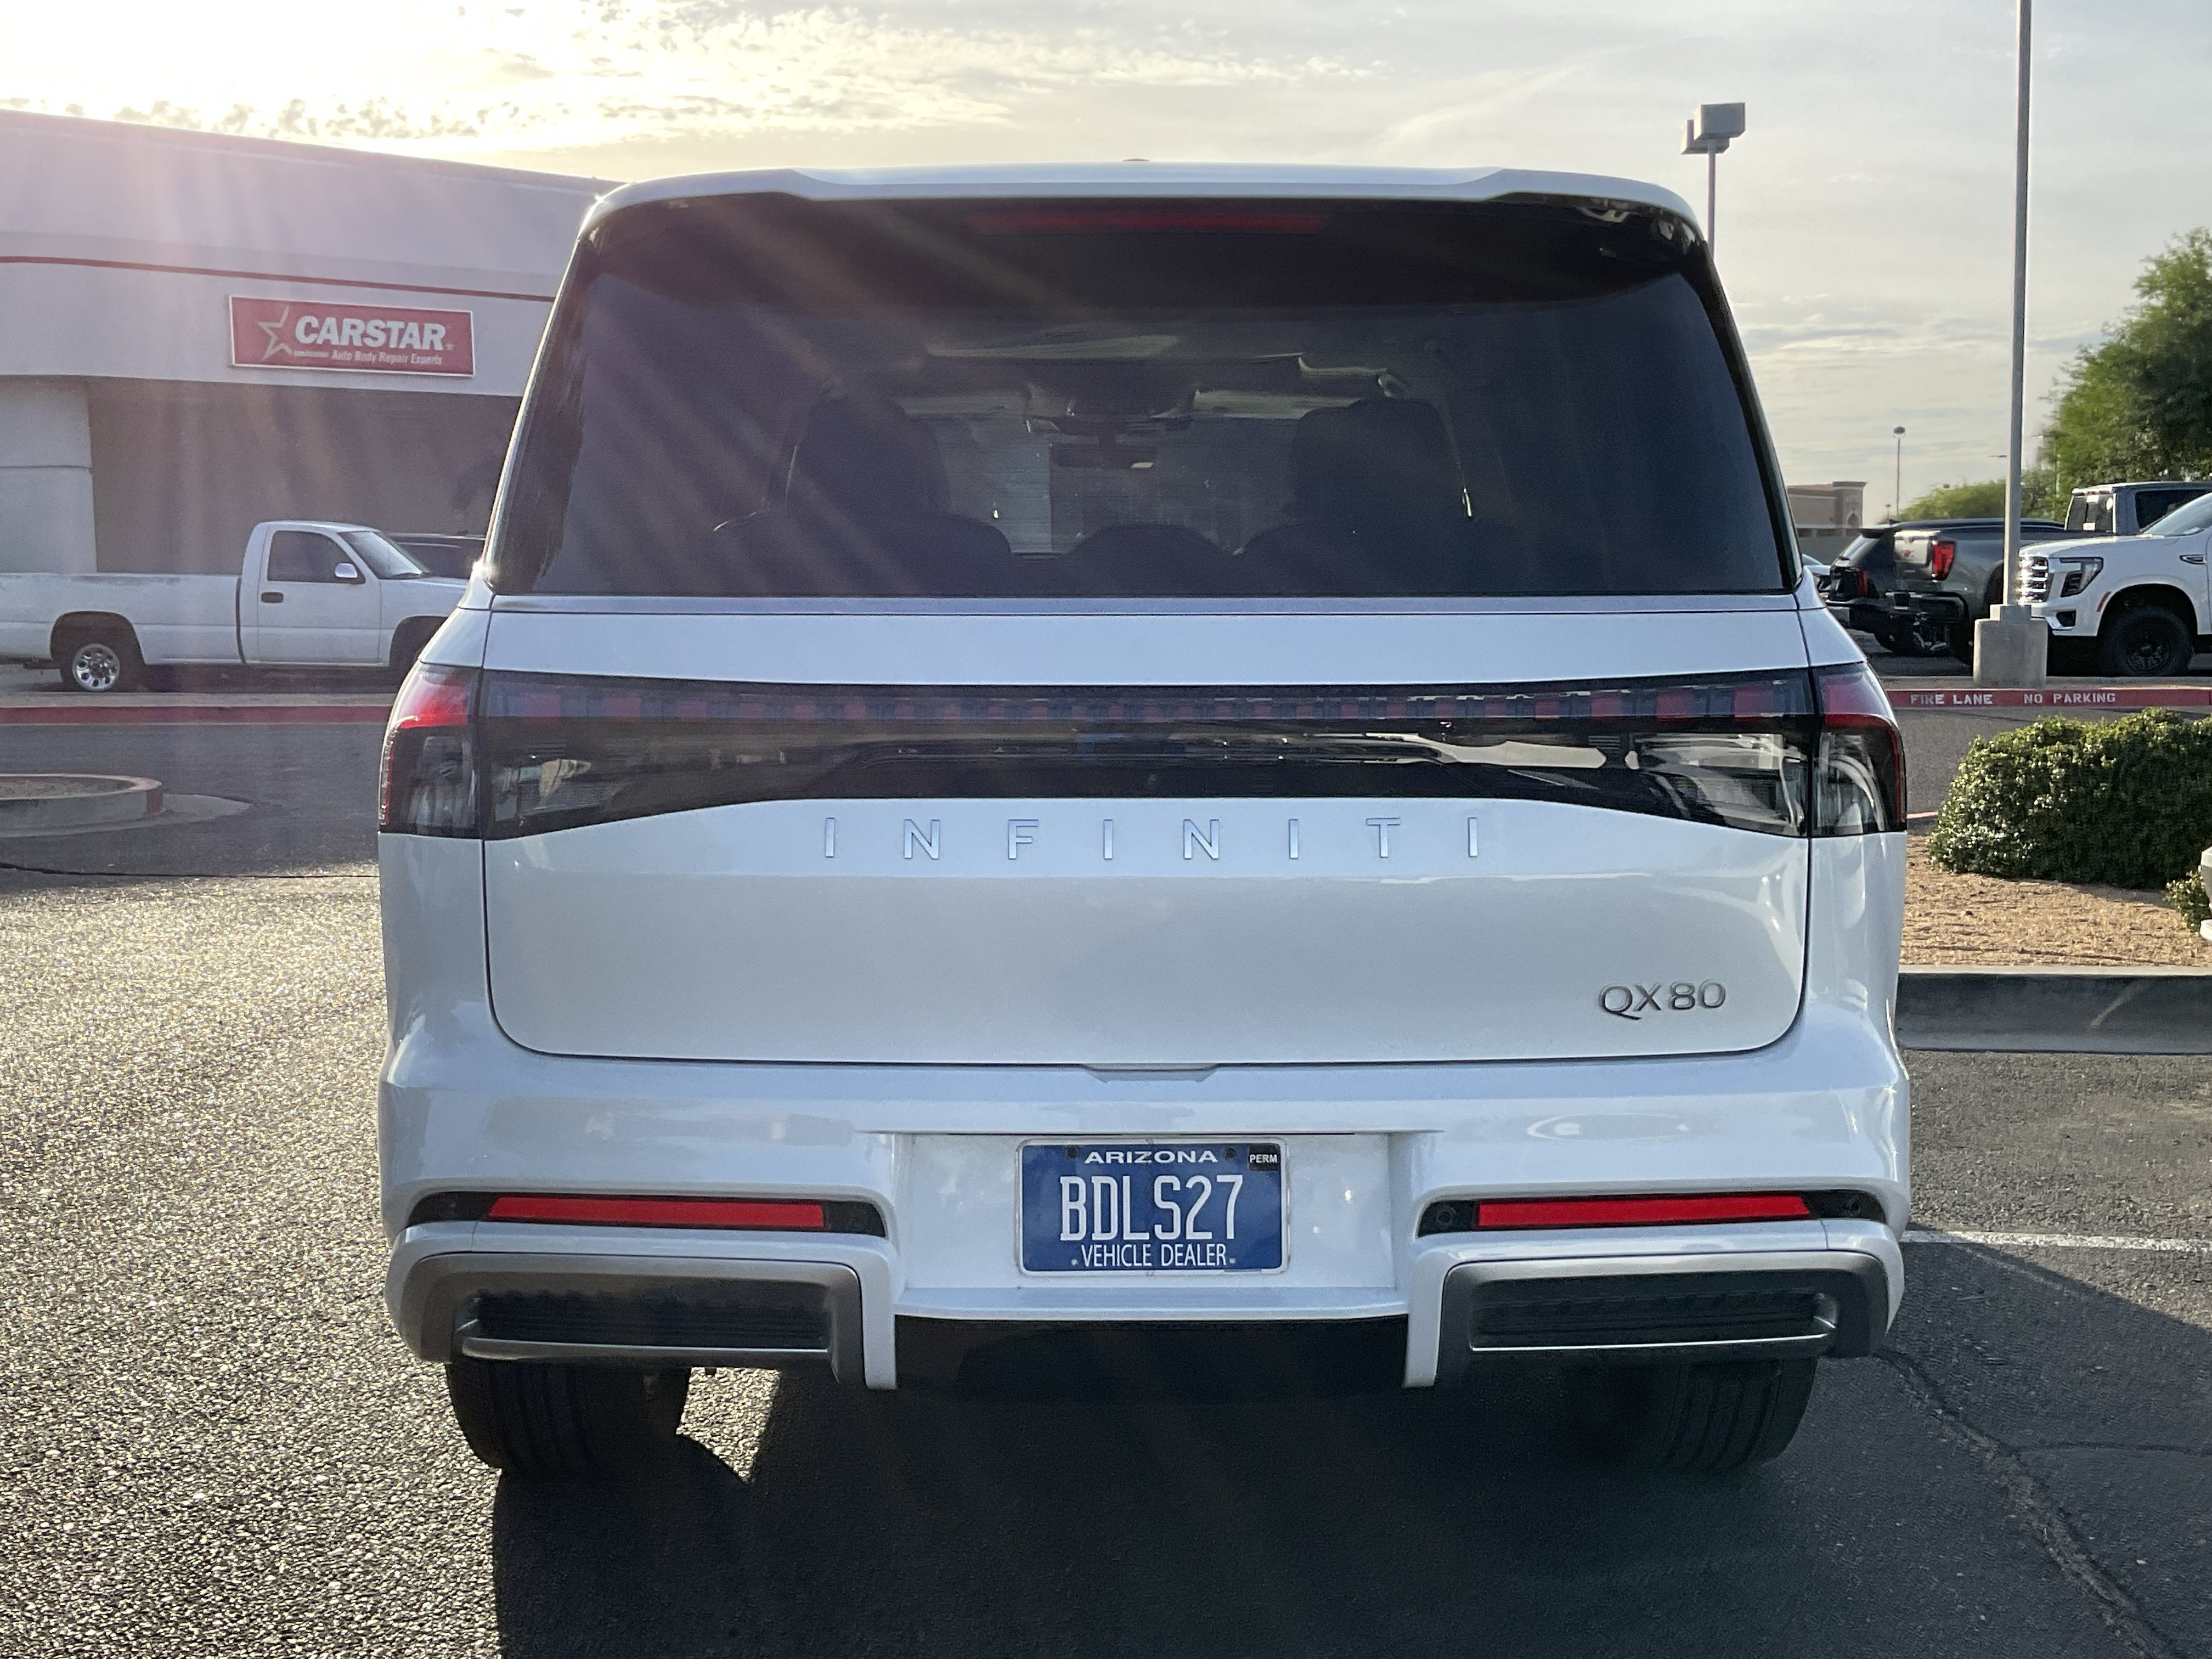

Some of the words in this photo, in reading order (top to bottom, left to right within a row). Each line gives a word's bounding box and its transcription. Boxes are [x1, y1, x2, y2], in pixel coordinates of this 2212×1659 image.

[295, 315, 446, 351] CARSTAR
[332, 349, 352, 360] Auto
[355, 351, 377, 363] Body
[379, 352, 409, 364] Repair
[411, 353, 442, 365] Experts
[1910, 694, 1944, 705] FIRE
[1953, 694, 1993, 705] LANE
[2024, 693, 2042, 704] NO
[2053, 693, 2116, 703] PARKING
[824, 817, 1478, 860] INFINITI
[1598, 979, 1726, 1020] QX80
[1085, 1150, 1218, 1164] ARIZONA
[1249, 1154, 1277, 1164] PERM
[1060, 1175, 1243, 1241] BDLS27
[1081, 1244, 1152, 1267] VEHICLE
[1161, 1243, 1226, 1266] DEALER
